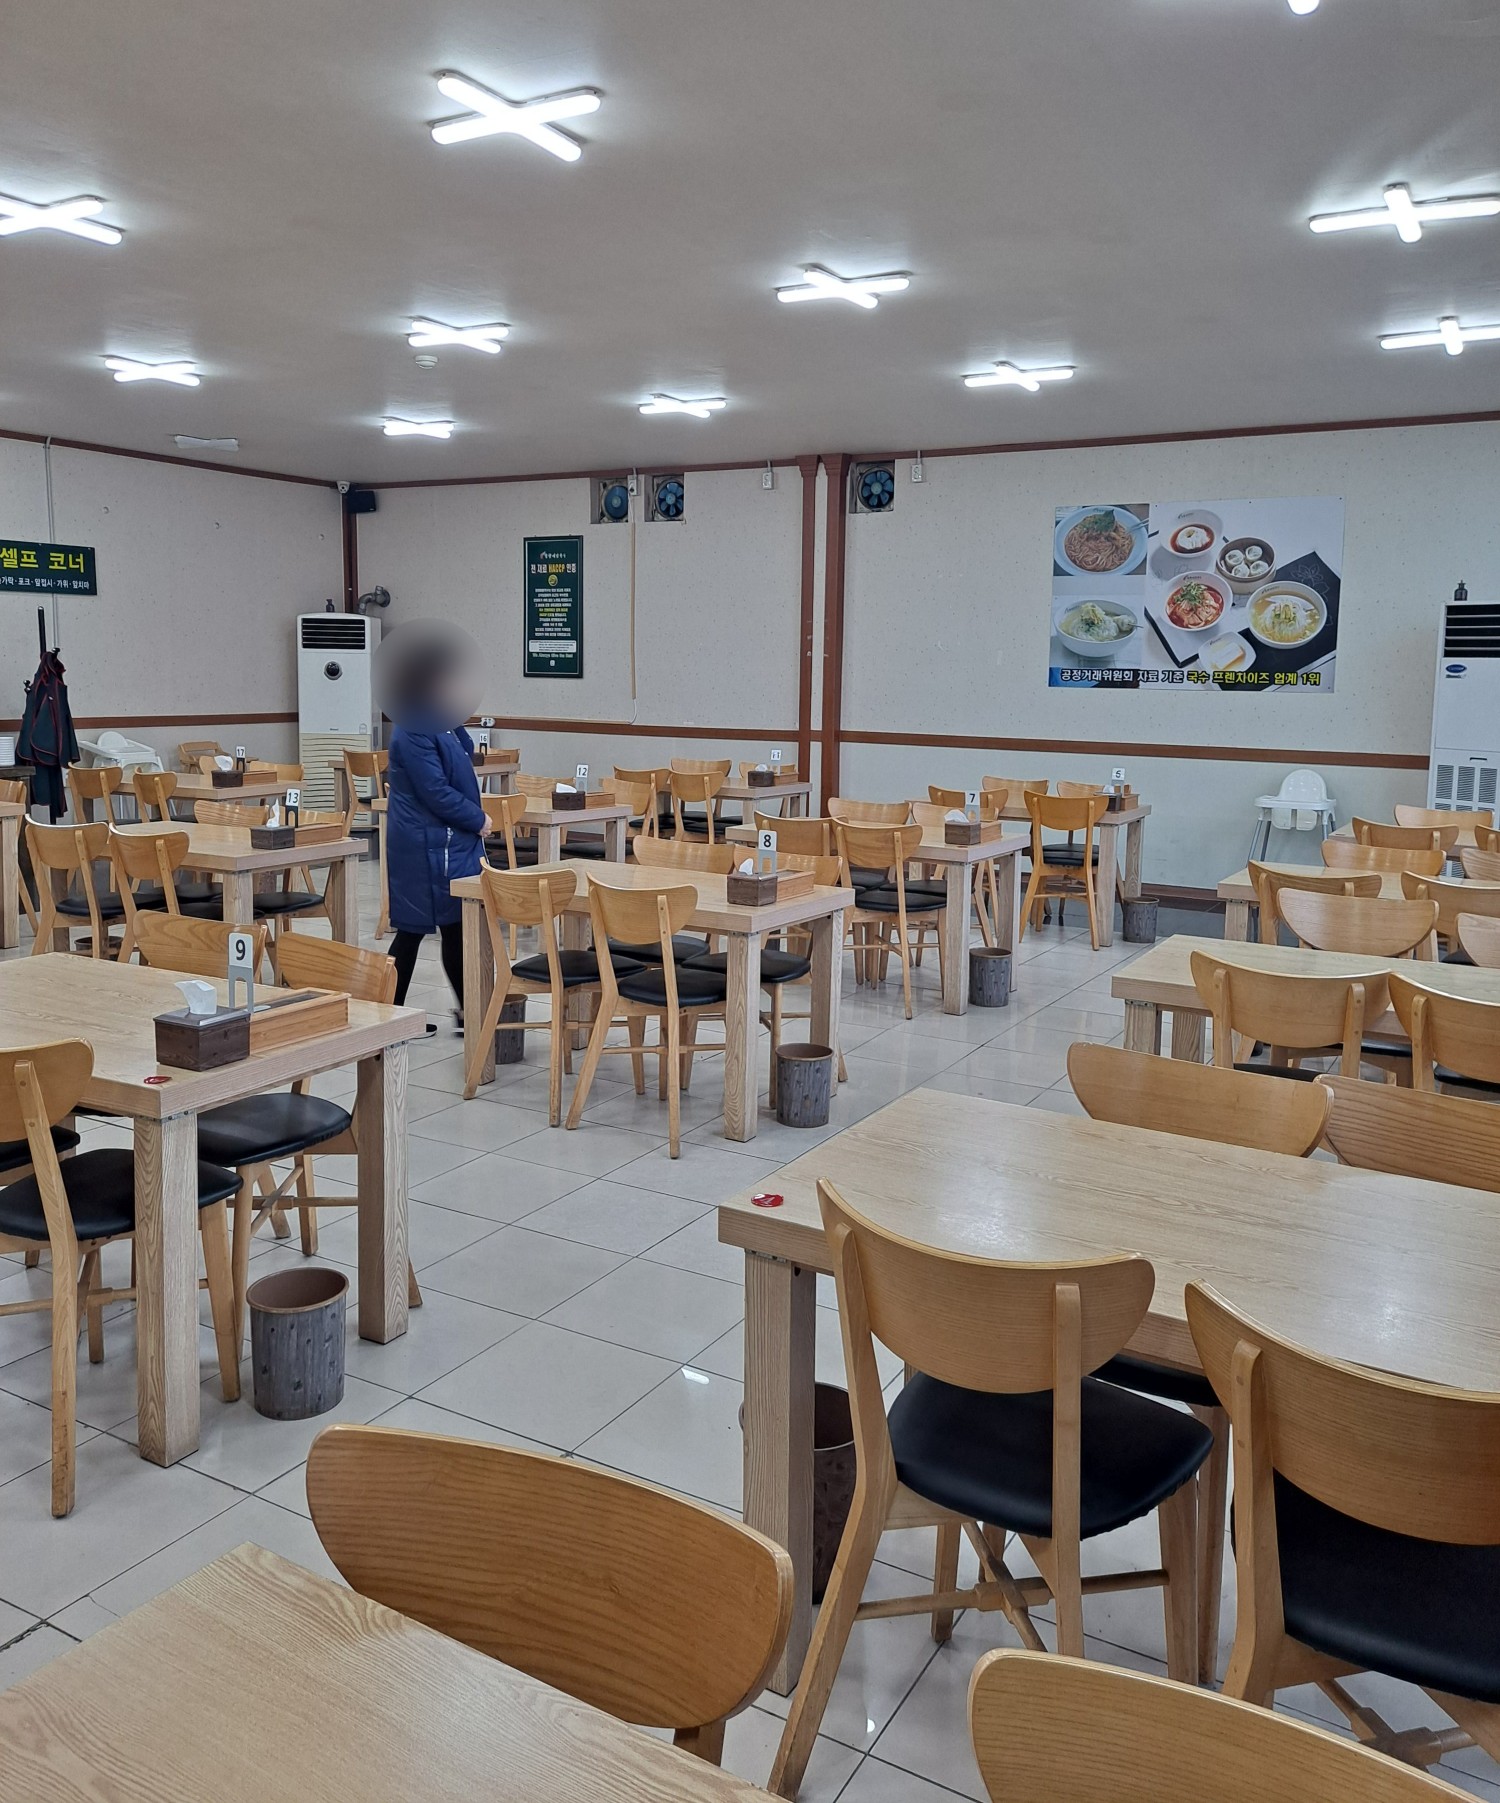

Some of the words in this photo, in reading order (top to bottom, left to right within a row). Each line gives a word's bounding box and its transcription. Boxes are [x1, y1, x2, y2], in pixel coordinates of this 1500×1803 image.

[0, 547, 39, 569] 셀프
[48, 552, 85, 573] 코너
[548, 563, 566, 573] HACCP
[0, 575, 14, 586] 가락
[1061, 669, 1134, 682] 공정거래위원회
[1138, 669, 1159, 682] 자료
[1160, 670, 1184, 683] 기준
[1187, 671, 1210, 684] 국수
[1213, 671, 1270, 685] 프렌차이즈
[1274, 672, 1297, 685] 업계
[1301, 672, 1321, 685] 1위
[236, 748, 245, 757] 17
[578, 766, 588, 776] 12
[288, 792, 299, 804] 13
[969, 792, 976, 804] 7
[763, 834, 772, 848] 8
[235, 939, 246, 961] 9
